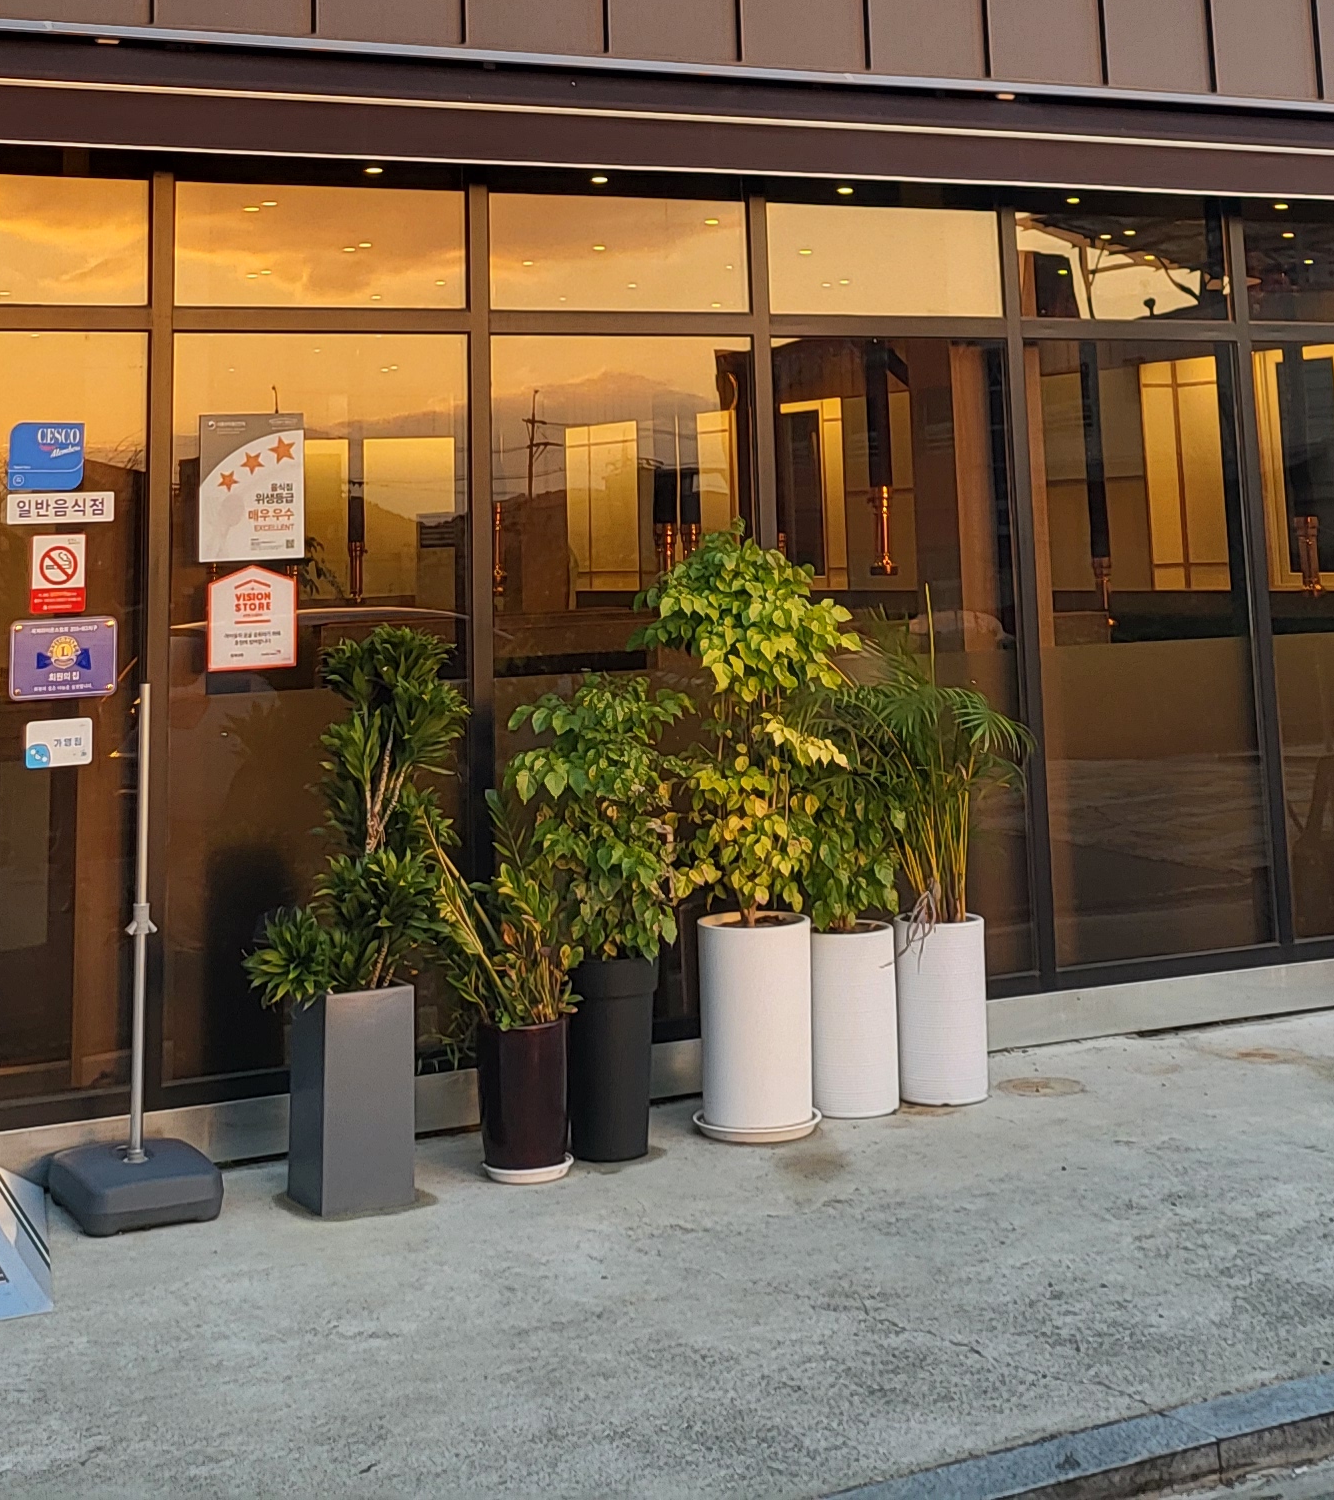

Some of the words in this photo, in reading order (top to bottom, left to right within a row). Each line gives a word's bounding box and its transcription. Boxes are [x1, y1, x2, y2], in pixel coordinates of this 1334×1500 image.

[37, 428, 80, 444] CESCO
[255, 492, 295, 505] 위생등급
[16, 497, 105, 519] 일반음식점
[248, 509, 270, 522] 매우
[272, 507, 295, 521] 우수
[254, 522, 295, 532] EXCELLENT
[235, 592, 271, 602] VISION
[235, 602, 271, 612] STORE
